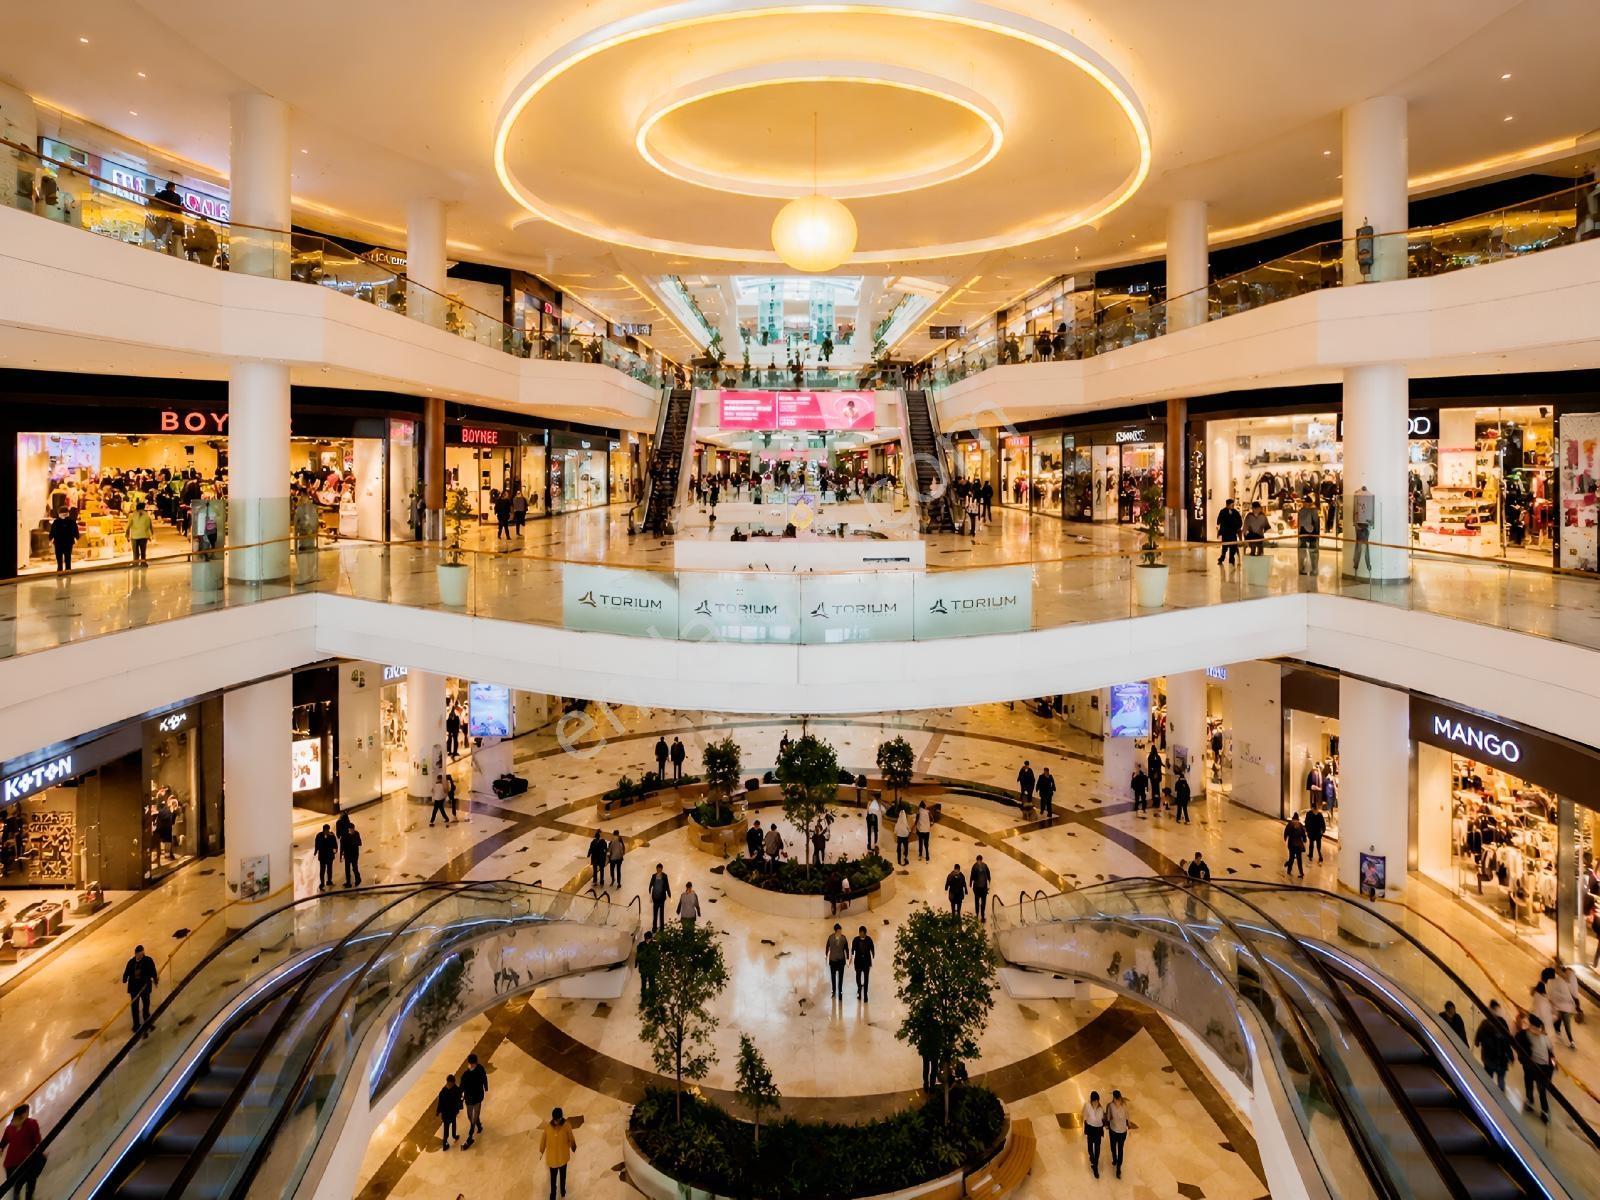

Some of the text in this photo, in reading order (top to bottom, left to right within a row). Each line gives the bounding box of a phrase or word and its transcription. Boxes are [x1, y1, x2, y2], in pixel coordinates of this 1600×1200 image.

[600, 594, 662, 609] TORIUM
[715, 603, 778, 615] TORIUM
[951, 595, 1017, 610] TORIUM
[1434, 716, 1520, 763] MANGO
